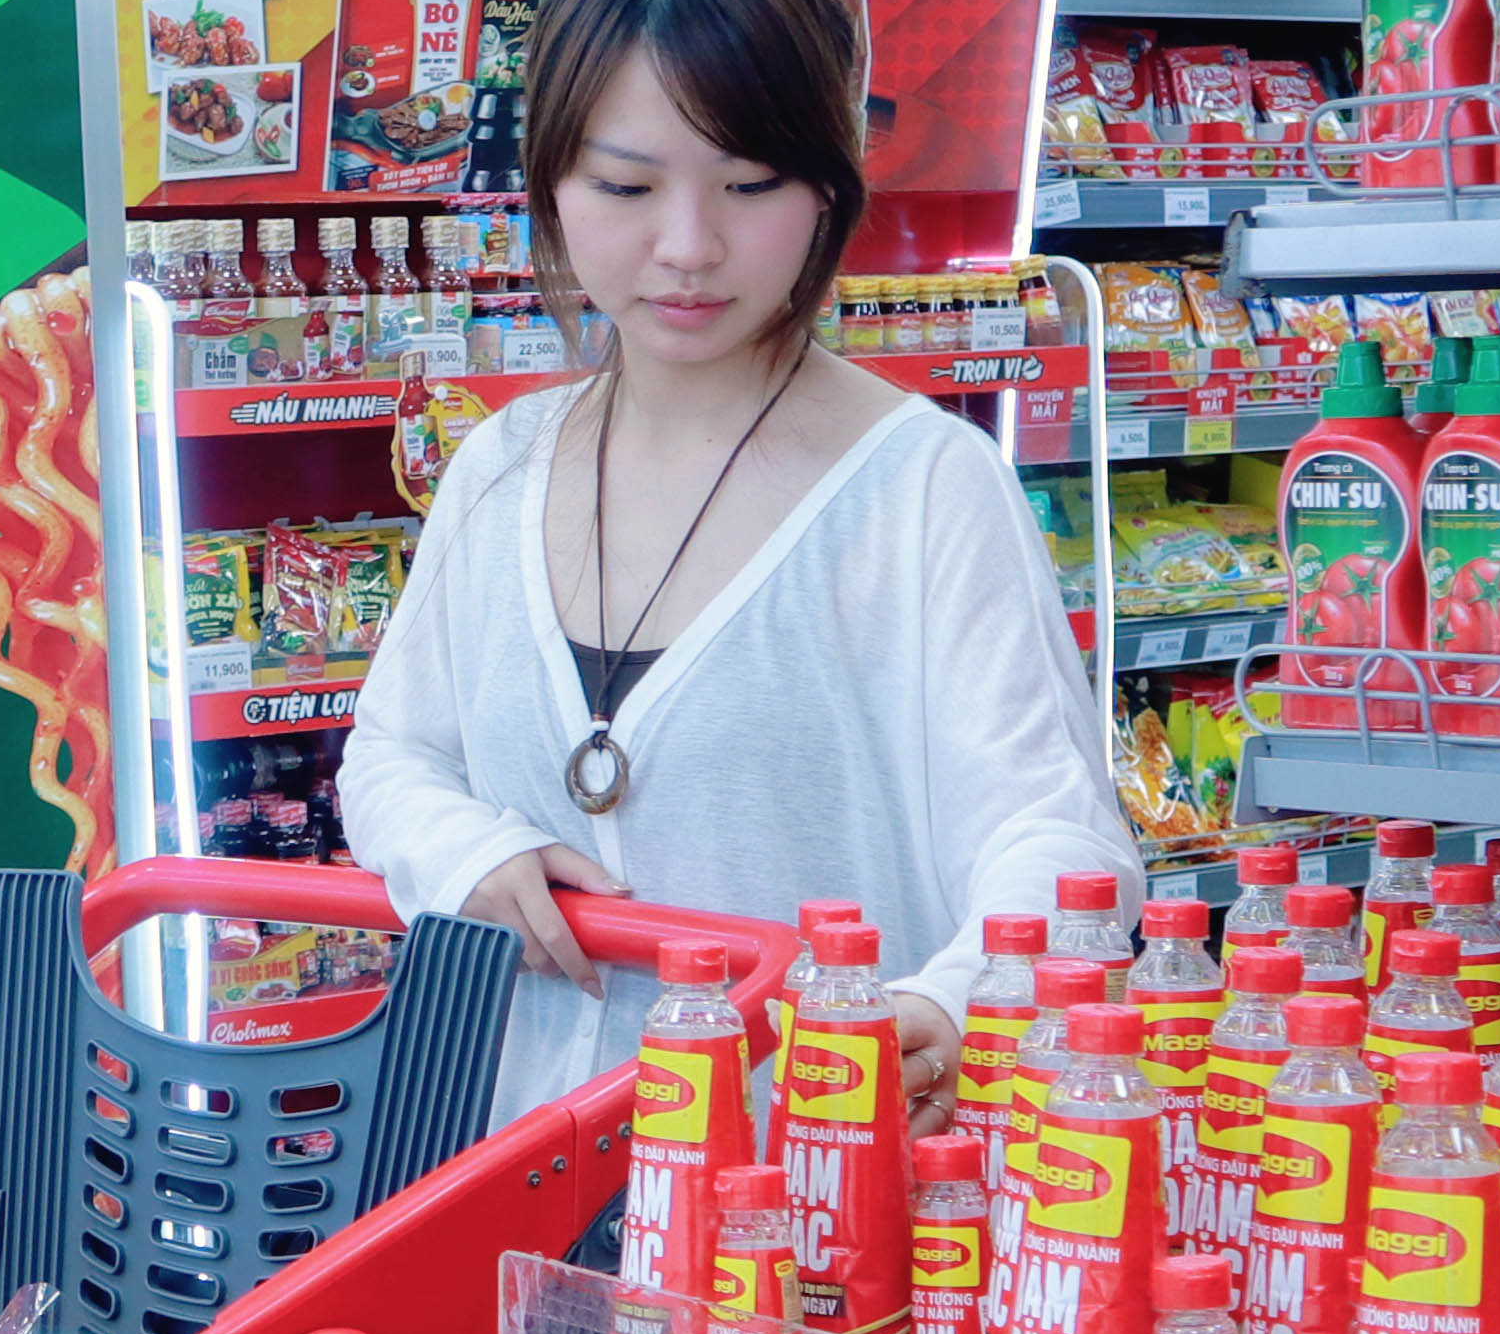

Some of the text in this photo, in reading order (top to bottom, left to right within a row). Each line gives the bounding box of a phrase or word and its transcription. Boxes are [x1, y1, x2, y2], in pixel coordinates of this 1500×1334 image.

[421, 28, 458, 53] NÉ
[952, 355, 1026, 385] TRỌN VỊ
[254, 393, 379, 424] NẤU NHANH
[1032, 401, 1058, 420] MÃI
[1291, 480, 1383, 512] CHIN-SU
[266, 690, 355, 721] TIỆN LỢI
